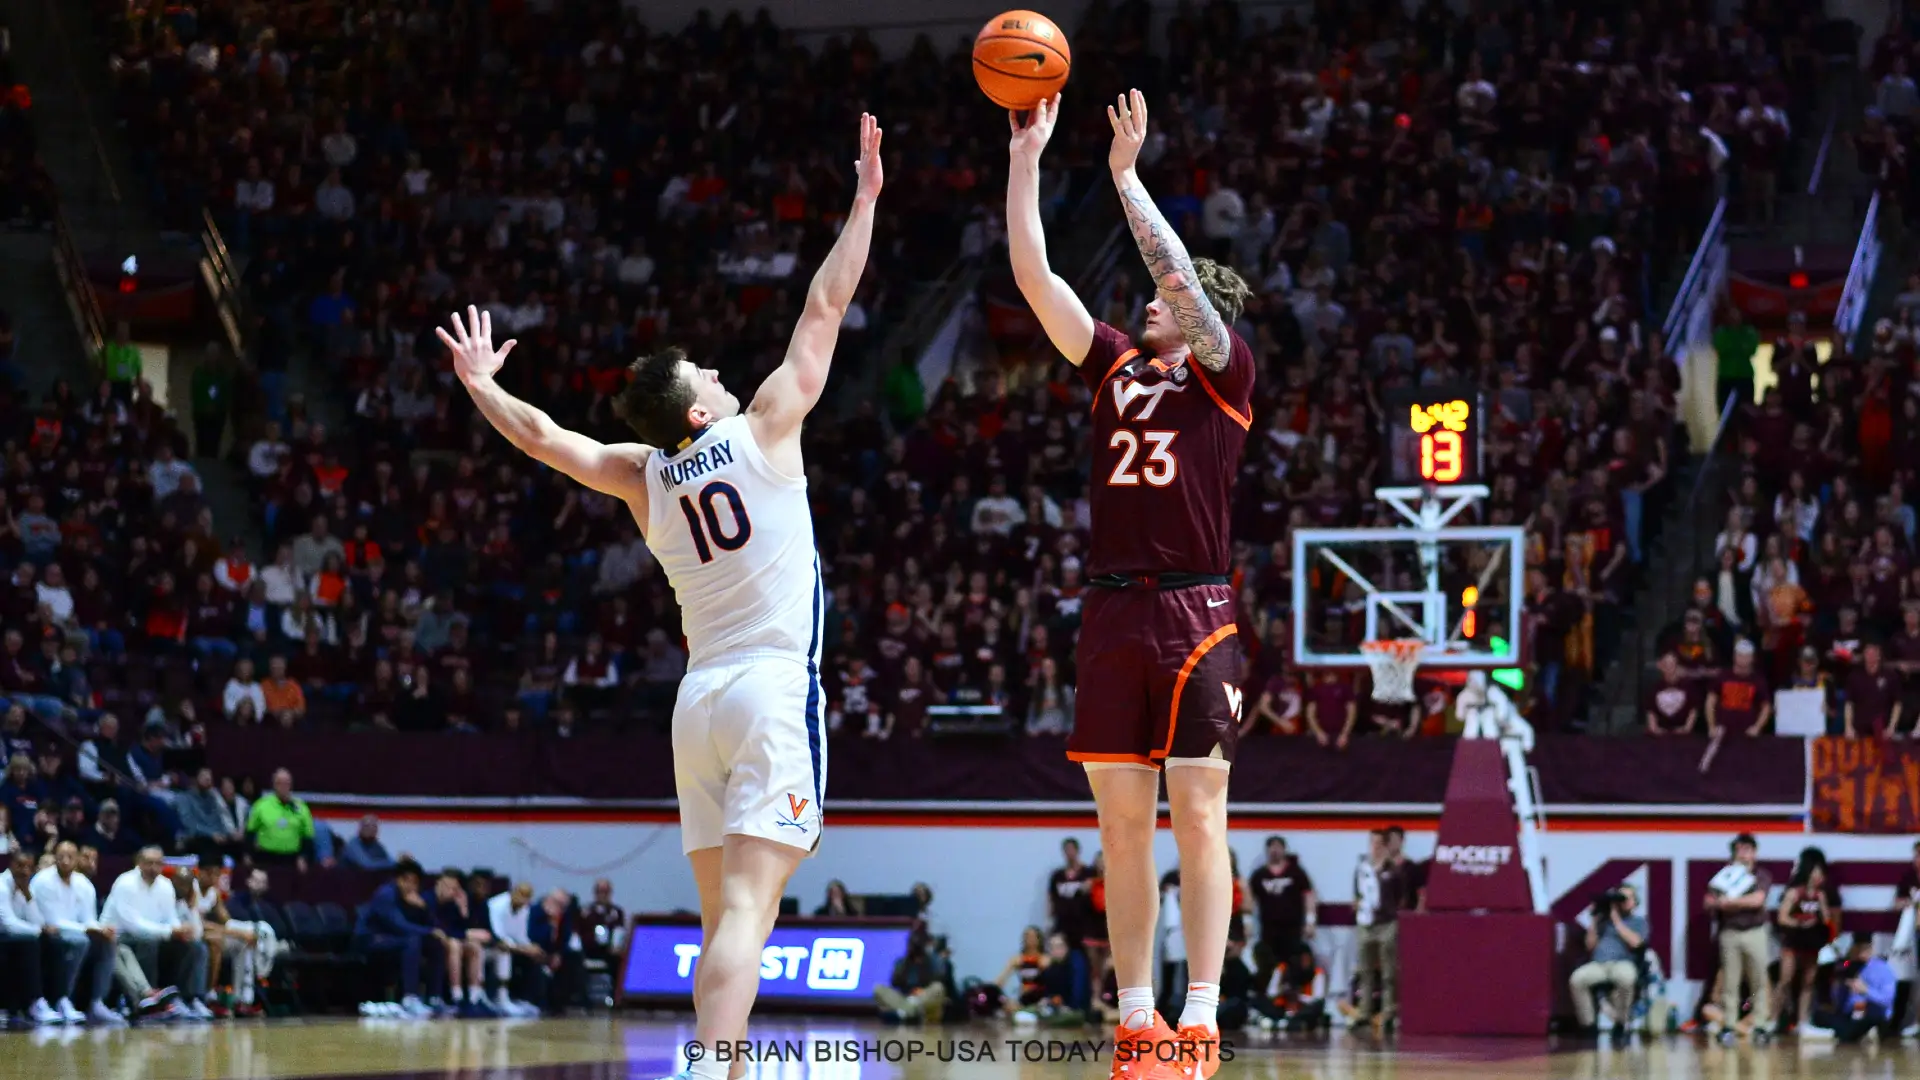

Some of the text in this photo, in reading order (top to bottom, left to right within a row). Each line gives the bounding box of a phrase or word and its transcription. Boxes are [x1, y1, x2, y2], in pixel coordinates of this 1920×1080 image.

[660, 440, 734, 493] MURRAY
[1107, 429, 1179, 487] 23
[1421, 431, 1462, 481] 13
[679, 479, 752, 564] 10
[1435, 845, 1512, 864] ROCKET
